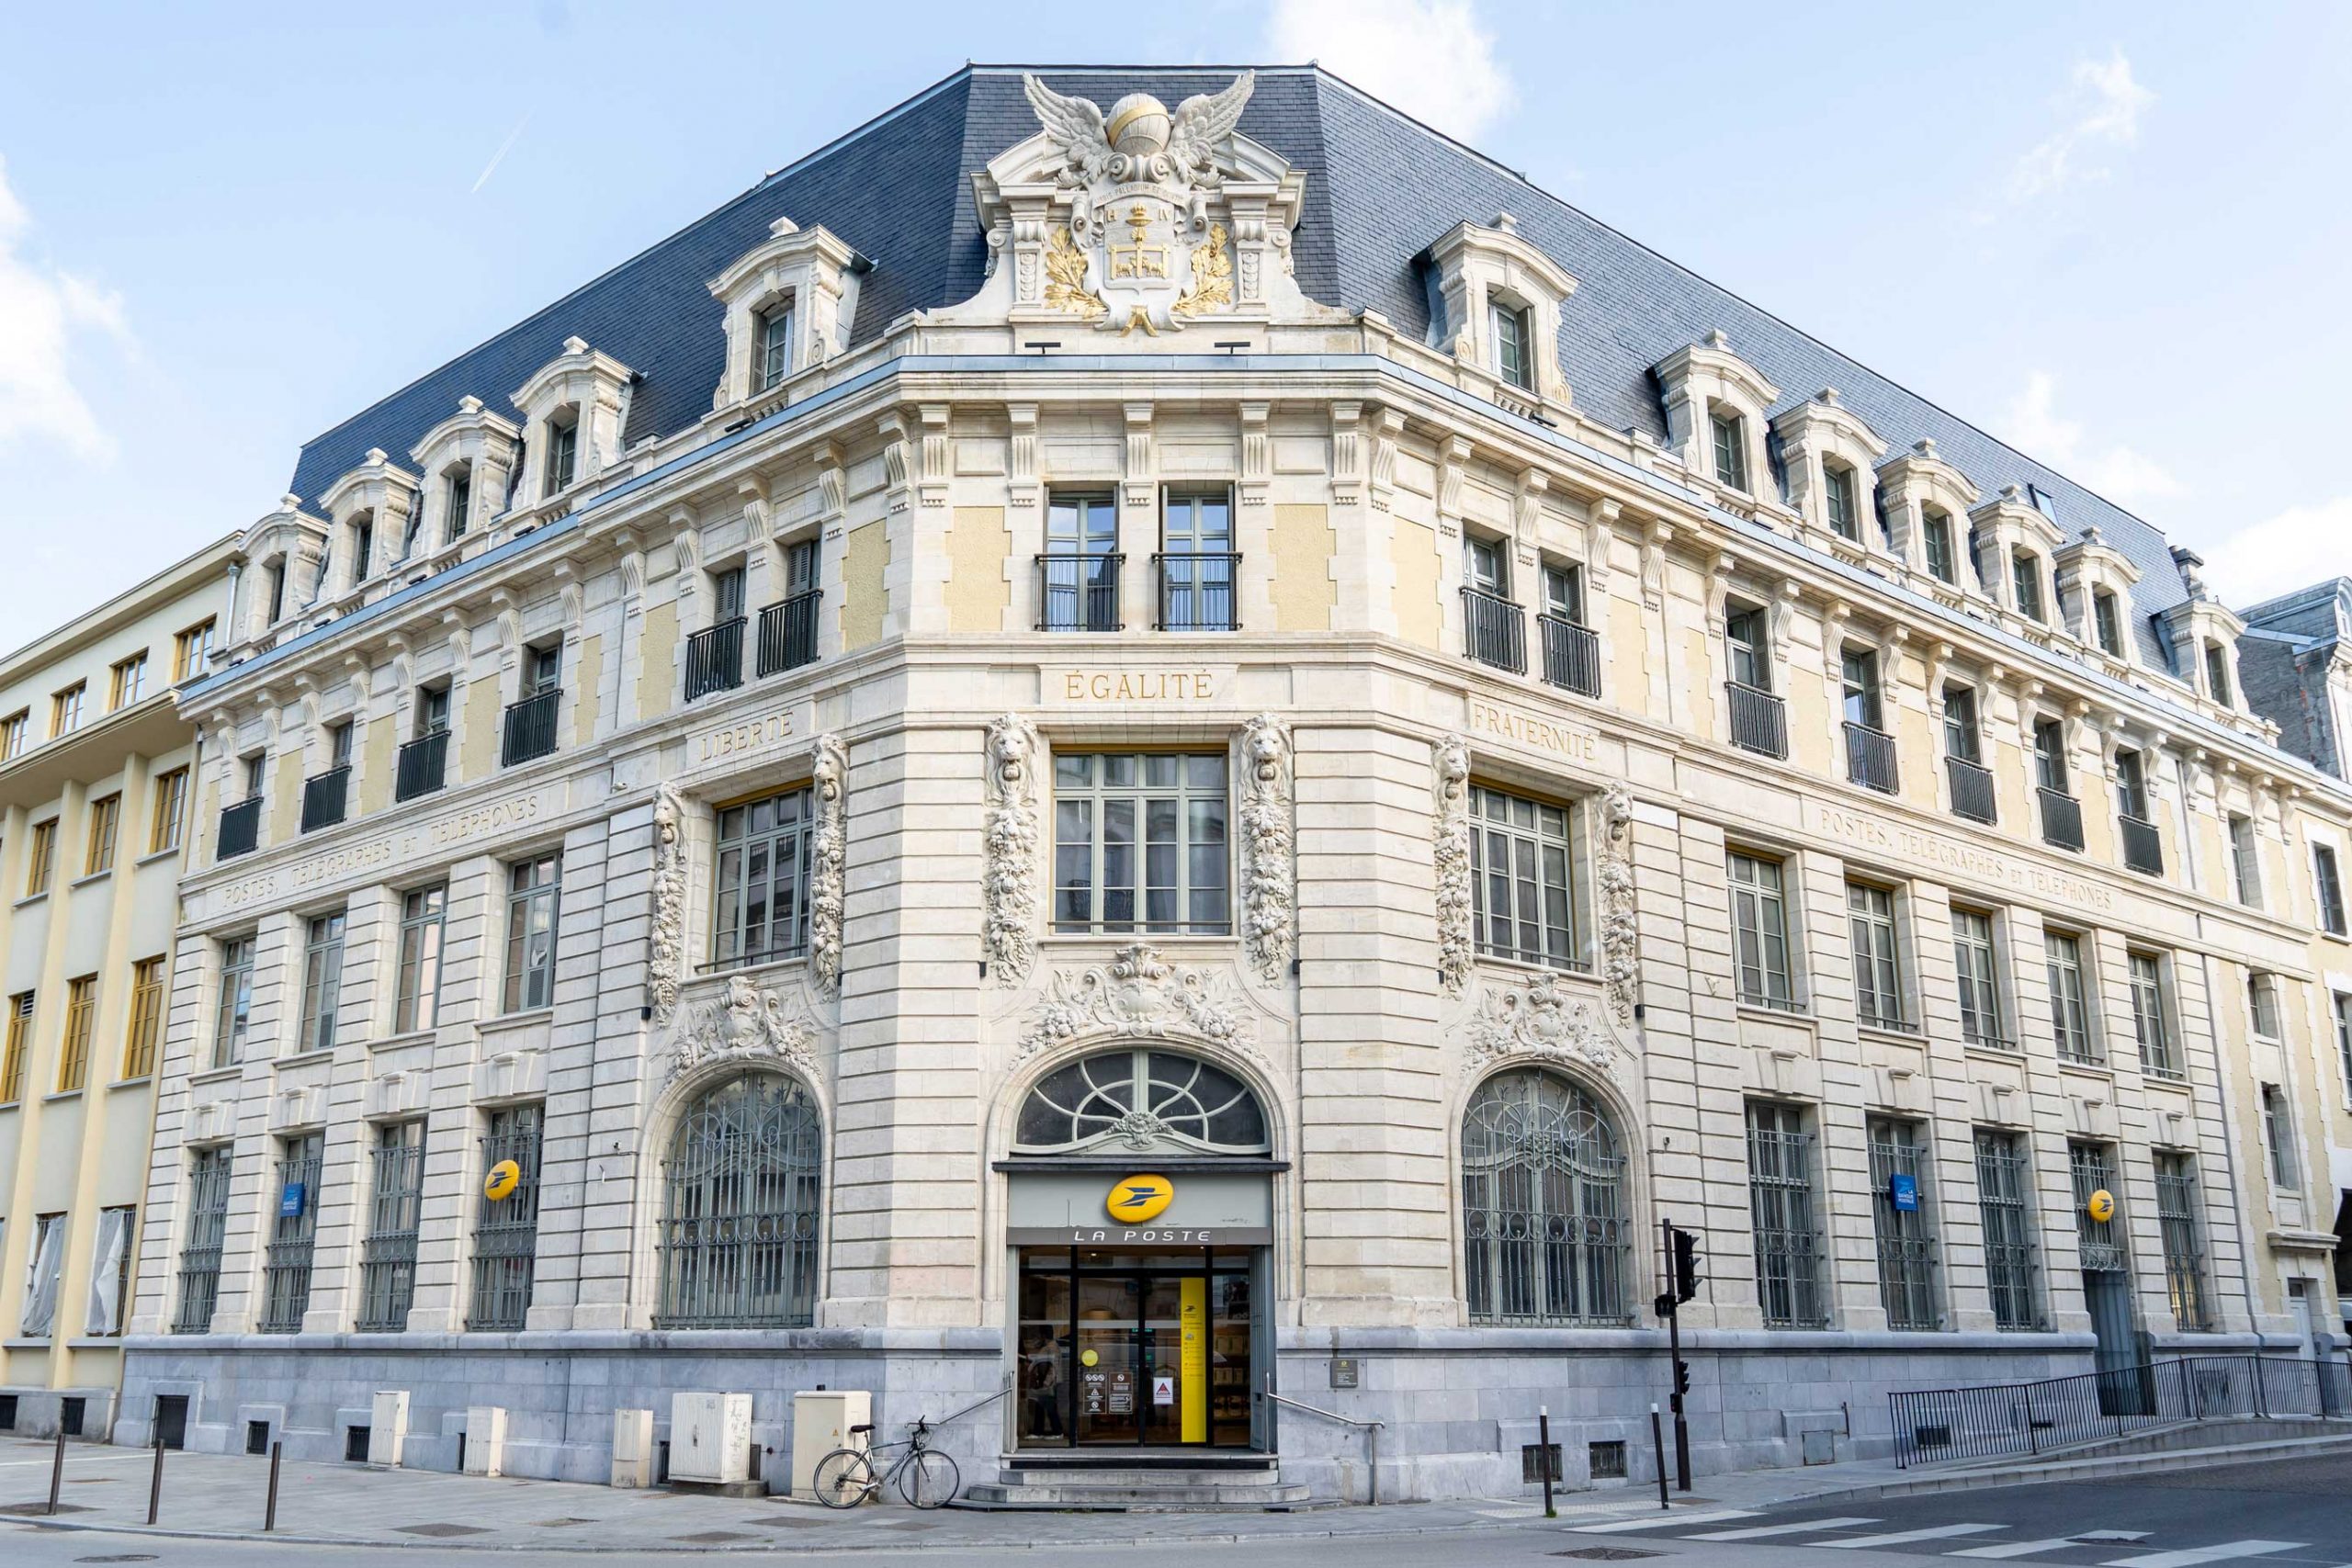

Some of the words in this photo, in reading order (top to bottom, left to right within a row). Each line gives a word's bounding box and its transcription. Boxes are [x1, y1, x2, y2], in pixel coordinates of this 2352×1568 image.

[1065, 669, 1213, 699] ÉGALITÉ
[1474, 704, 1596, 761] FRATERNITÉ
[1074, 1230, 1105, 1241] LA
[1124, 1230, 1211, 1241] POSTE
